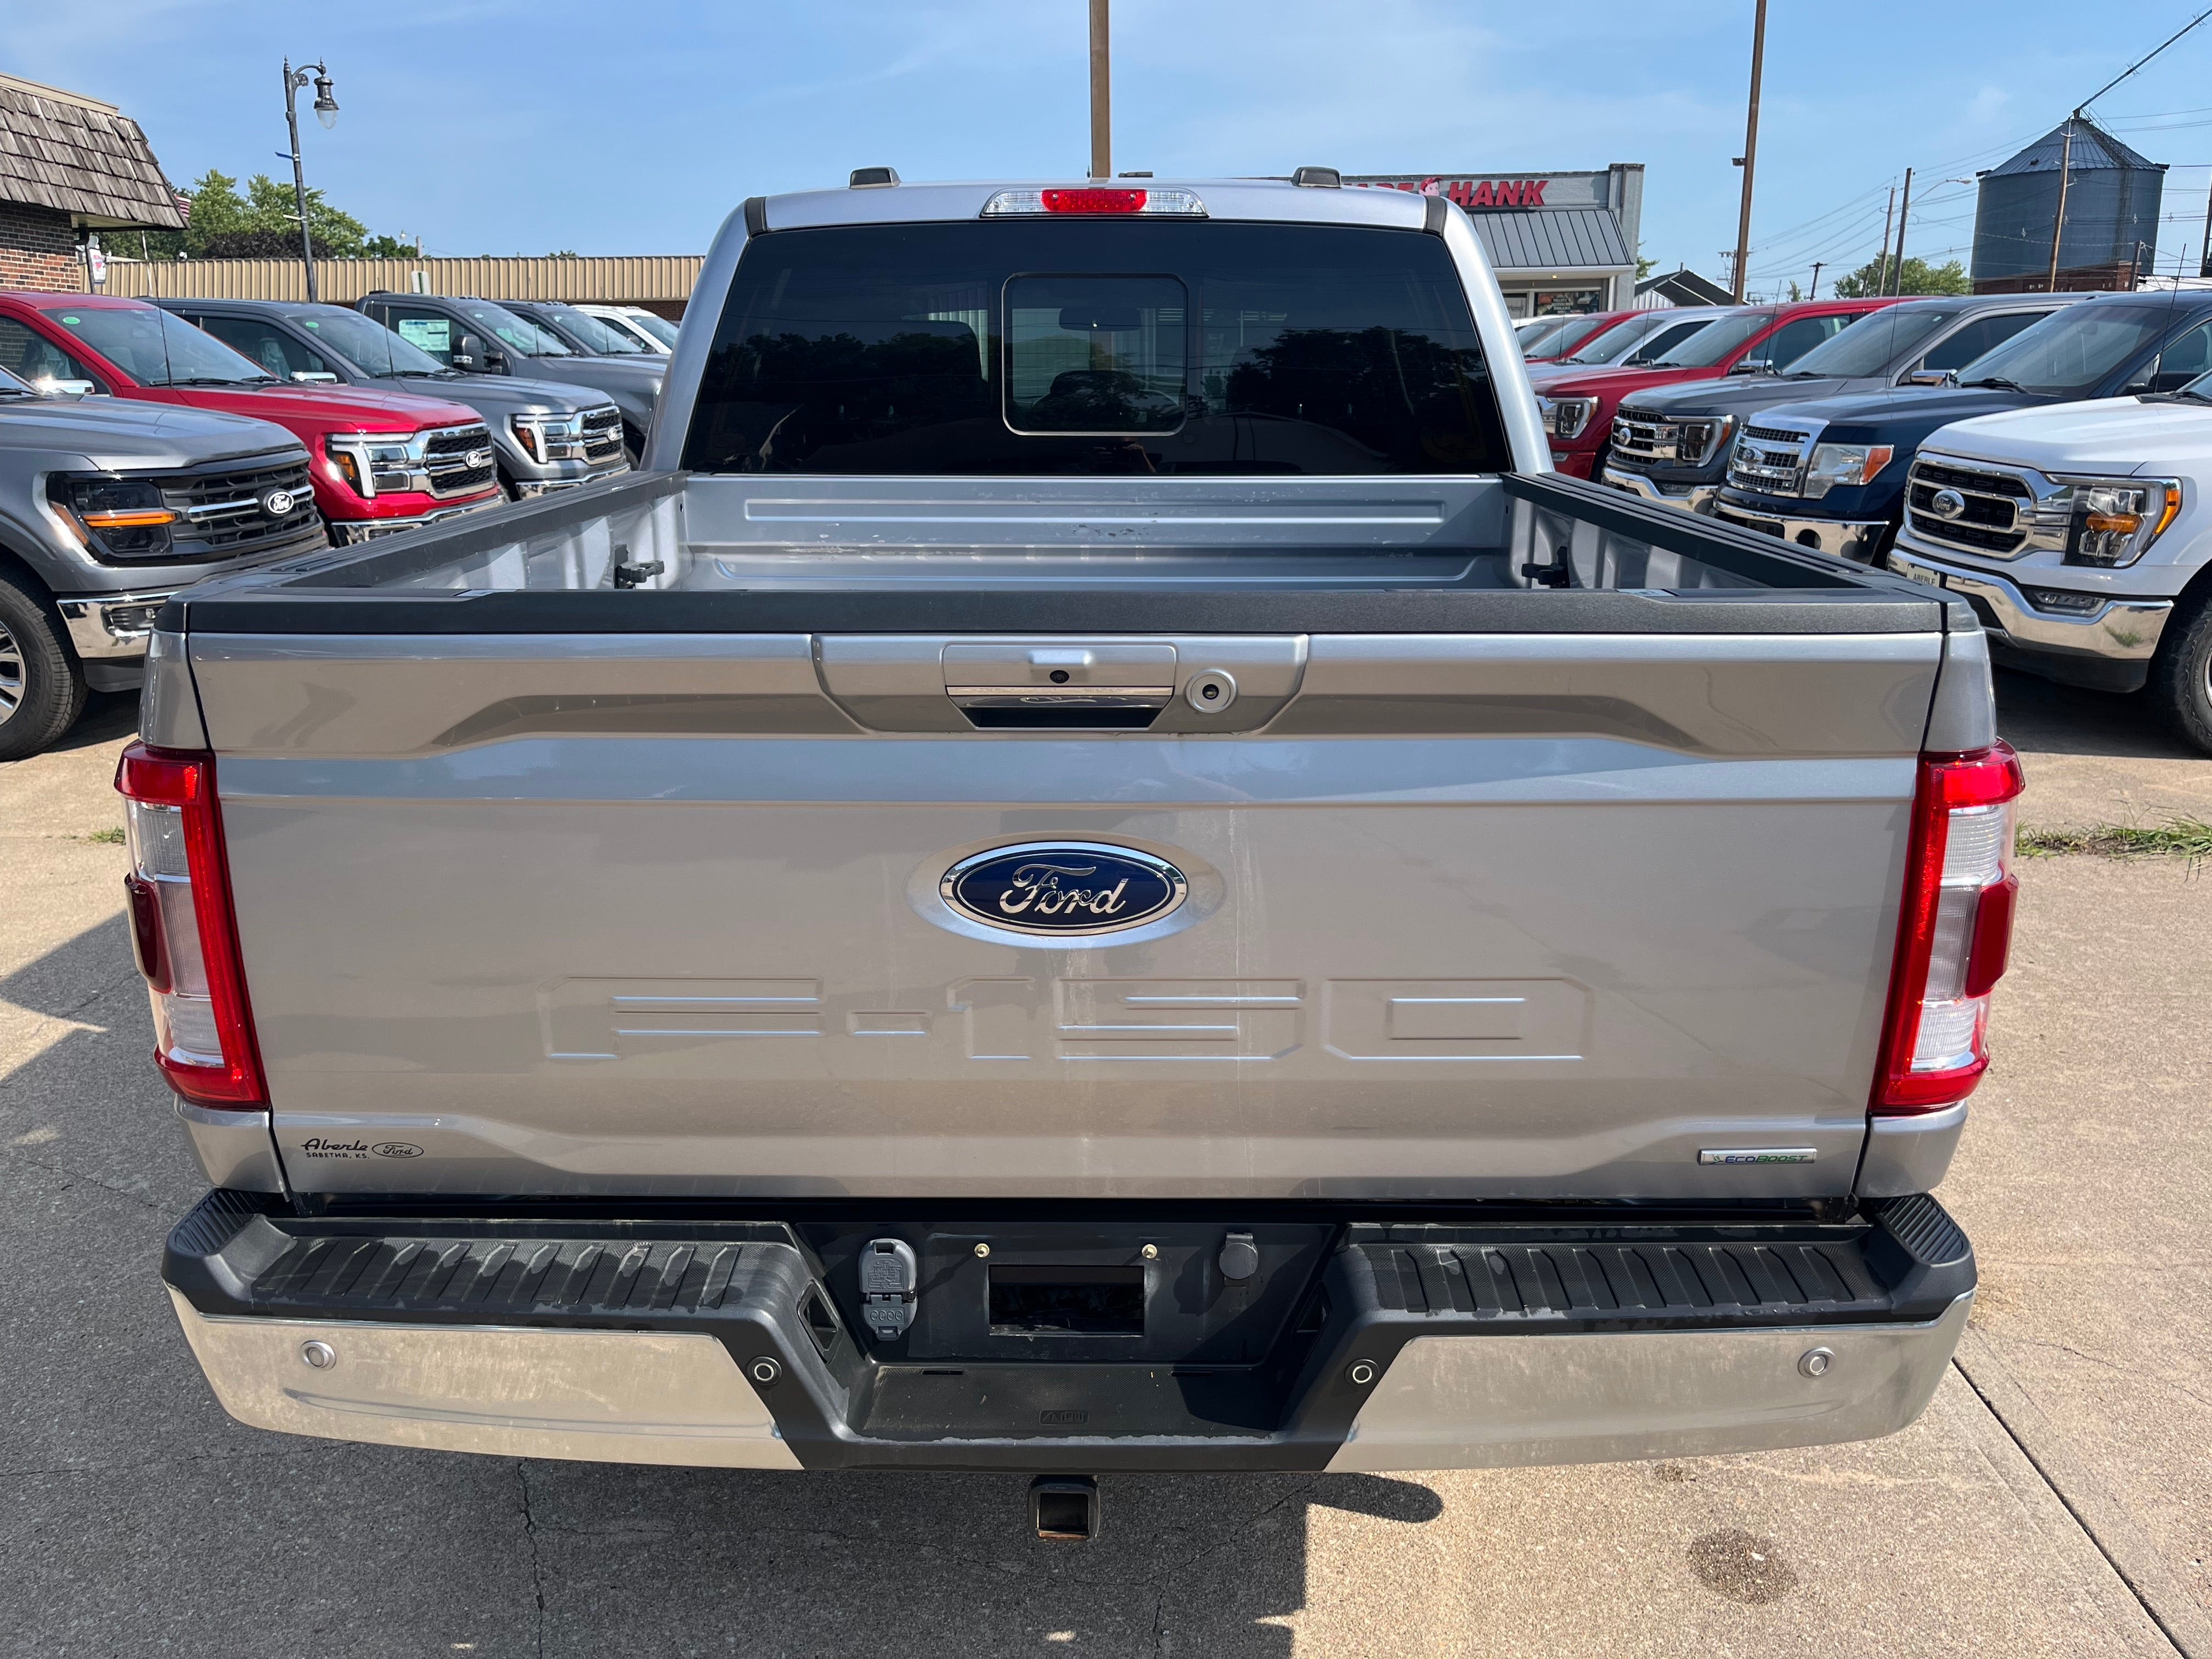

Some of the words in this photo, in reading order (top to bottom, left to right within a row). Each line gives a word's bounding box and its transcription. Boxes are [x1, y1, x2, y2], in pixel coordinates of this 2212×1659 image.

[1448, 180, 1549, 207] HANK
[999, 864, 1127, 915] Ford
[536, 975, 1595, 1061] F-150
[301, 1138, 368, 1151] Aberle
[383, 1144, 413, 1155] Ford
